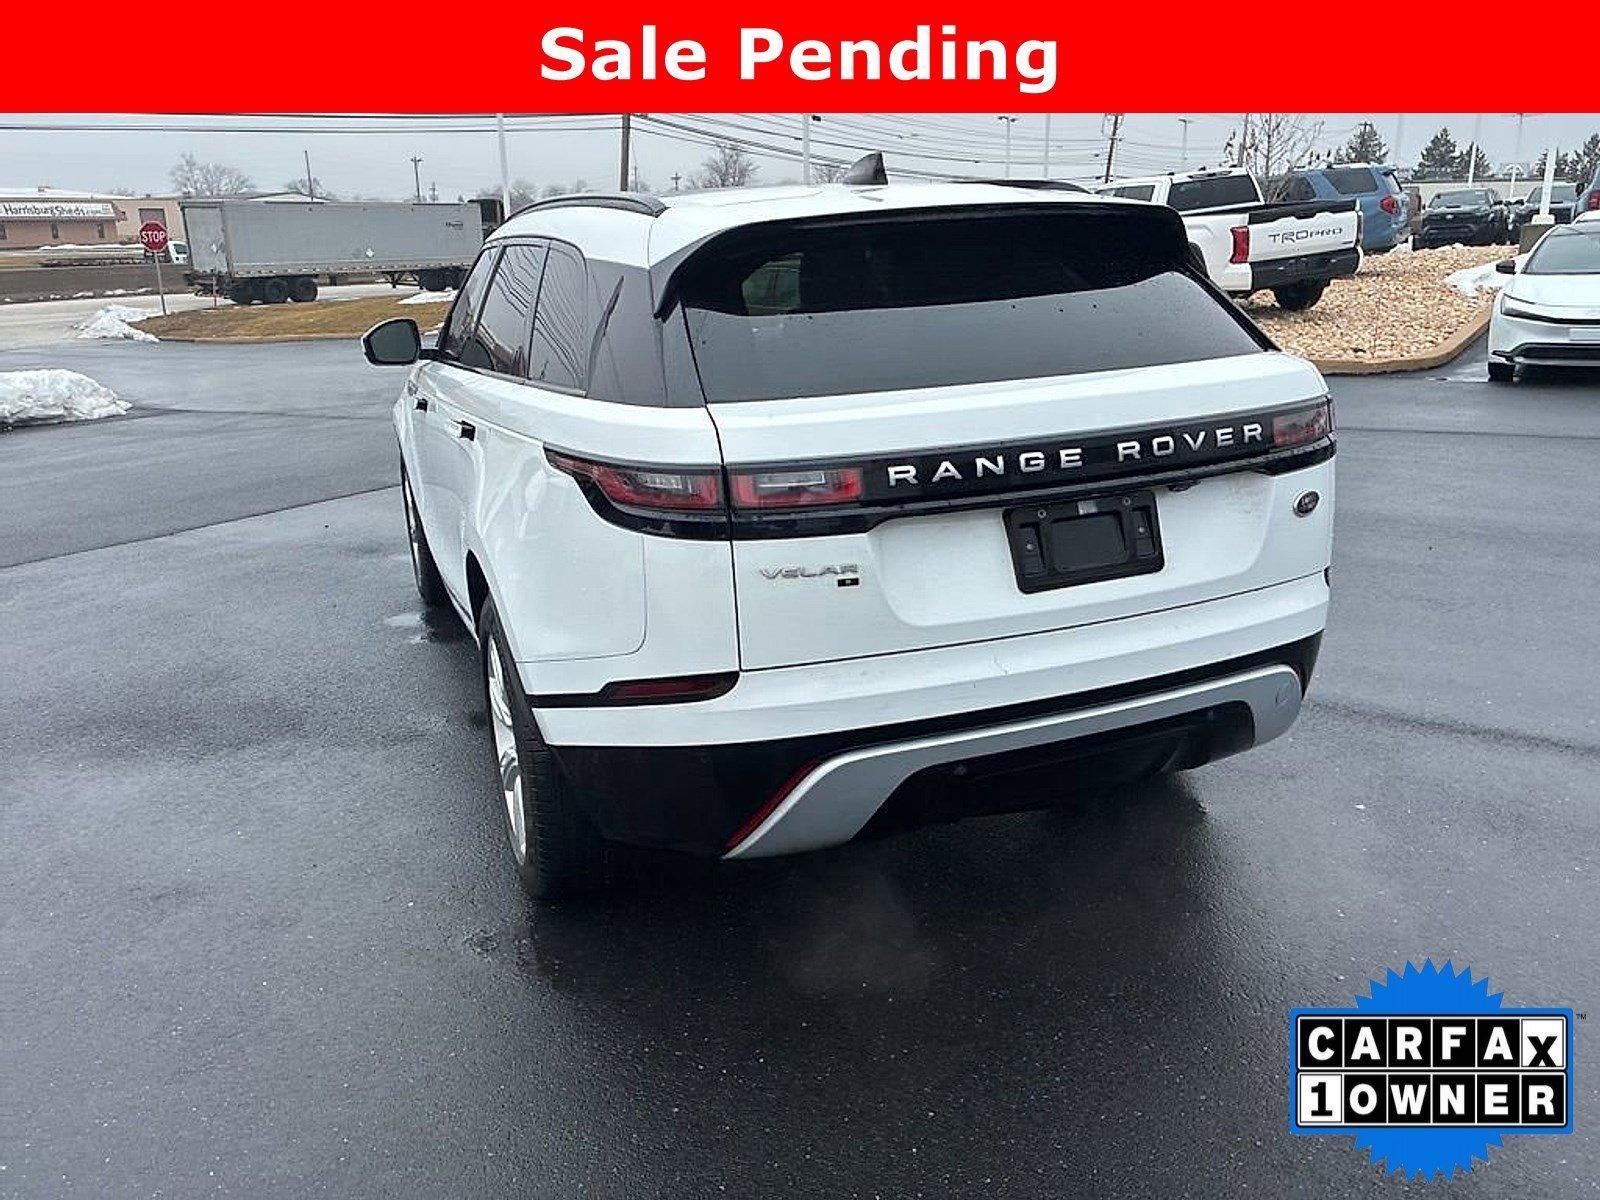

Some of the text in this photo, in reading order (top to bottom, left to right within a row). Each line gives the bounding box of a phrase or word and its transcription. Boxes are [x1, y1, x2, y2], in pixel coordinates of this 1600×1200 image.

[140, 230, 166, 243] STOP
[887, 423, 1265, 488] RANGE ROVER
[760, 564, 859, 580] VELAR
